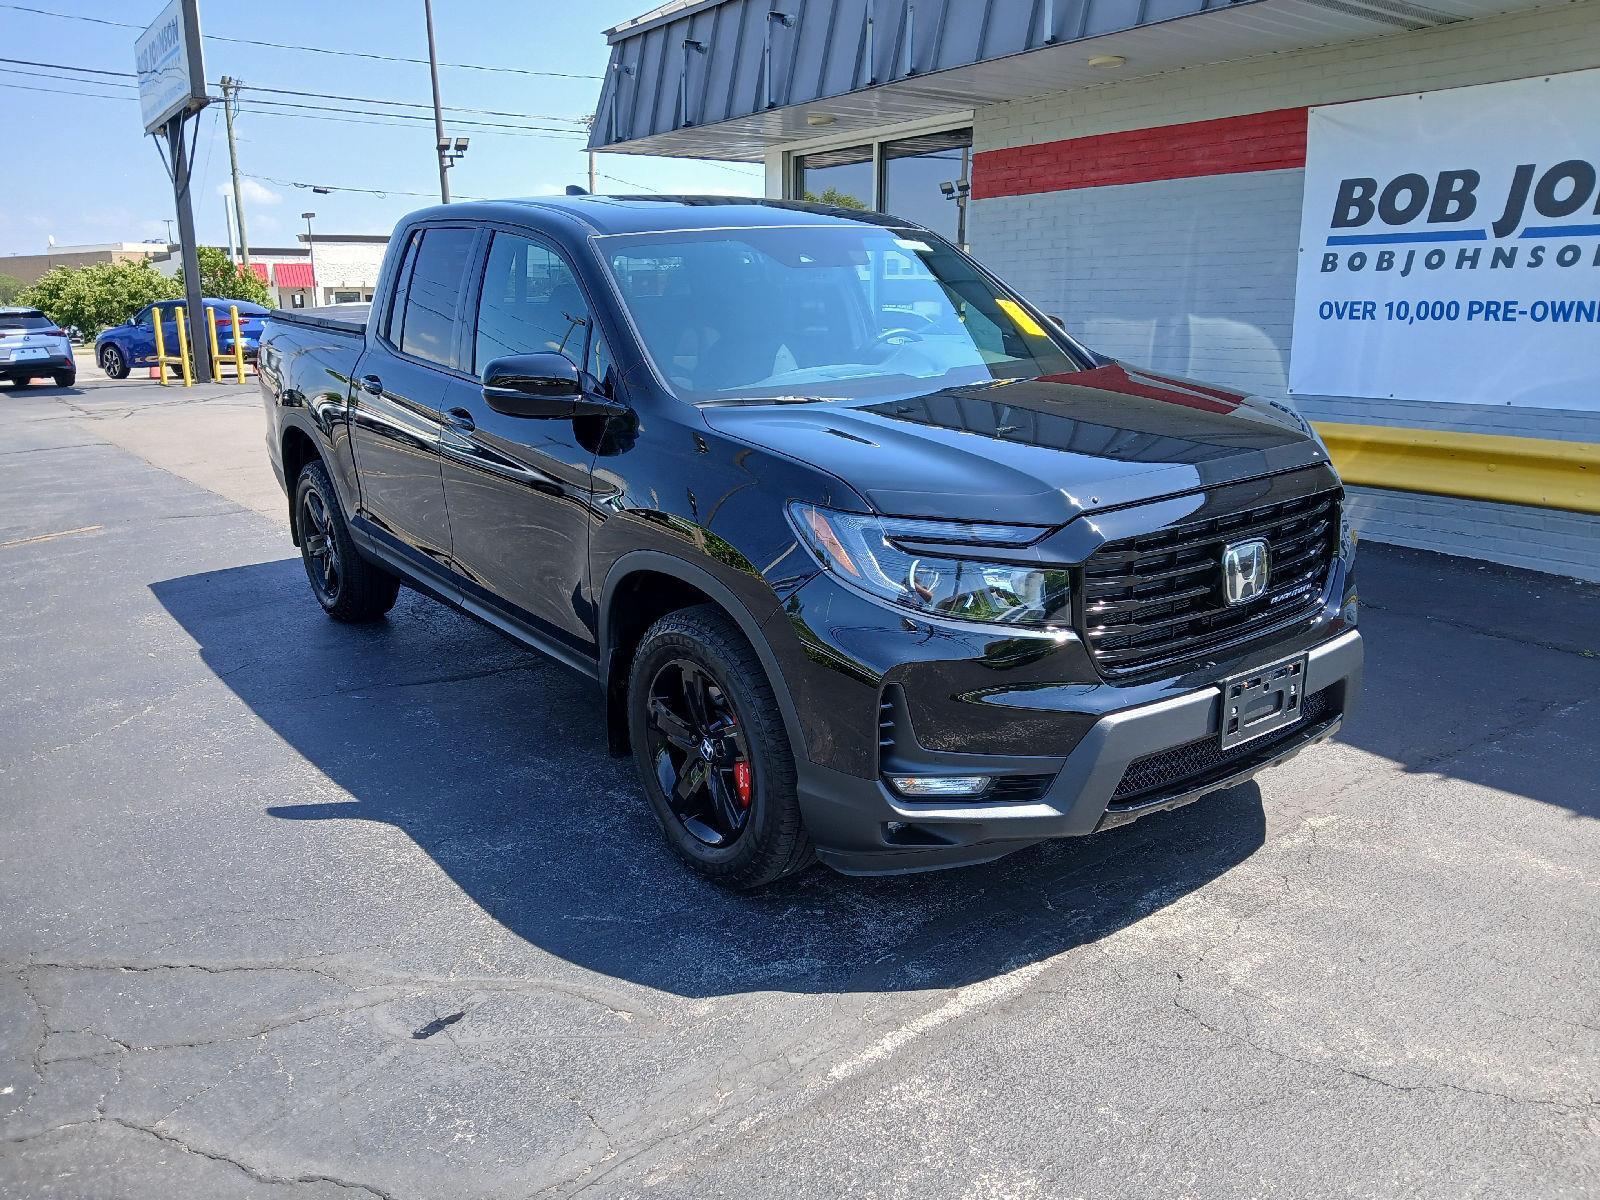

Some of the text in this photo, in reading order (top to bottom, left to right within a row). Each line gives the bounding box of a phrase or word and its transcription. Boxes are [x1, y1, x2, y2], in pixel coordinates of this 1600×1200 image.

[1330, 159, 1600, 238] BOB JO
[1319, 300, 1600, 325] OVER 10,000 PRE-OWN
